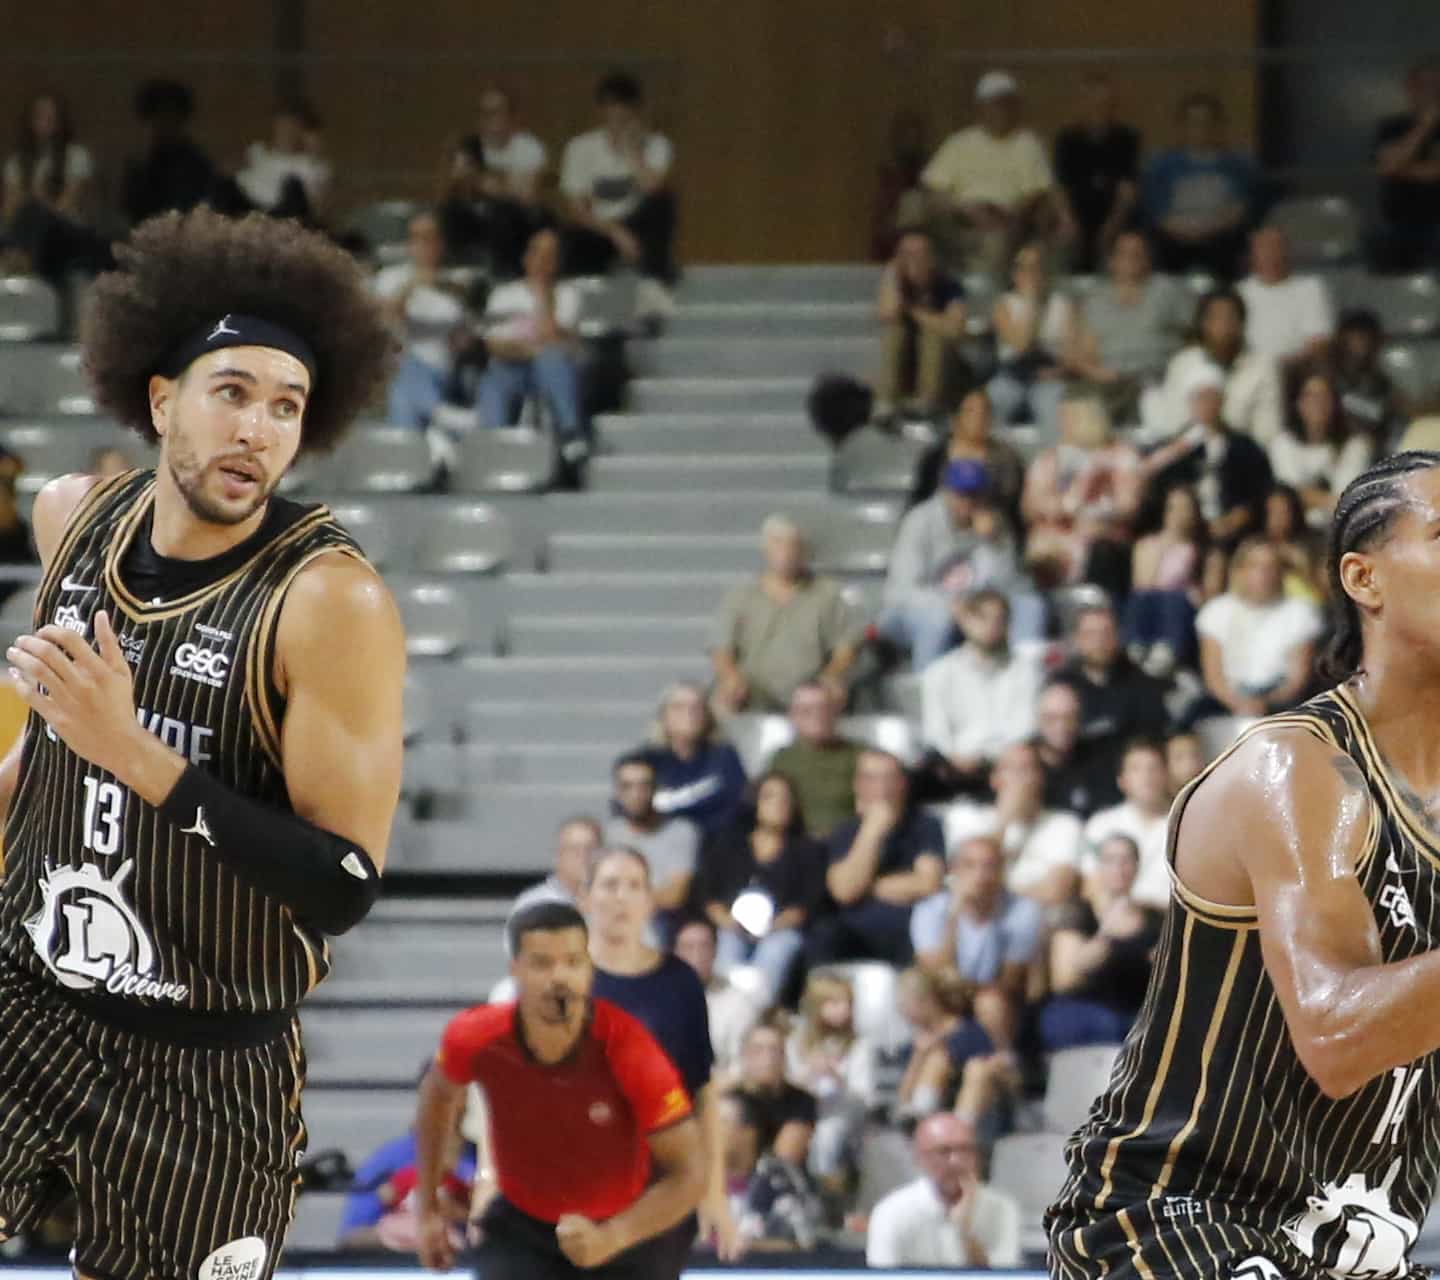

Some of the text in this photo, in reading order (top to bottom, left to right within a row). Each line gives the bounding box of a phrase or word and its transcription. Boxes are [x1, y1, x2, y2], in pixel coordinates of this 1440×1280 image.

[174, 641, 230, 679] GSC
[82, 775, 124, 856] 13
[106, 963, 190, 1002] Océane
[1371, 1066, 1425, 1145] 14
